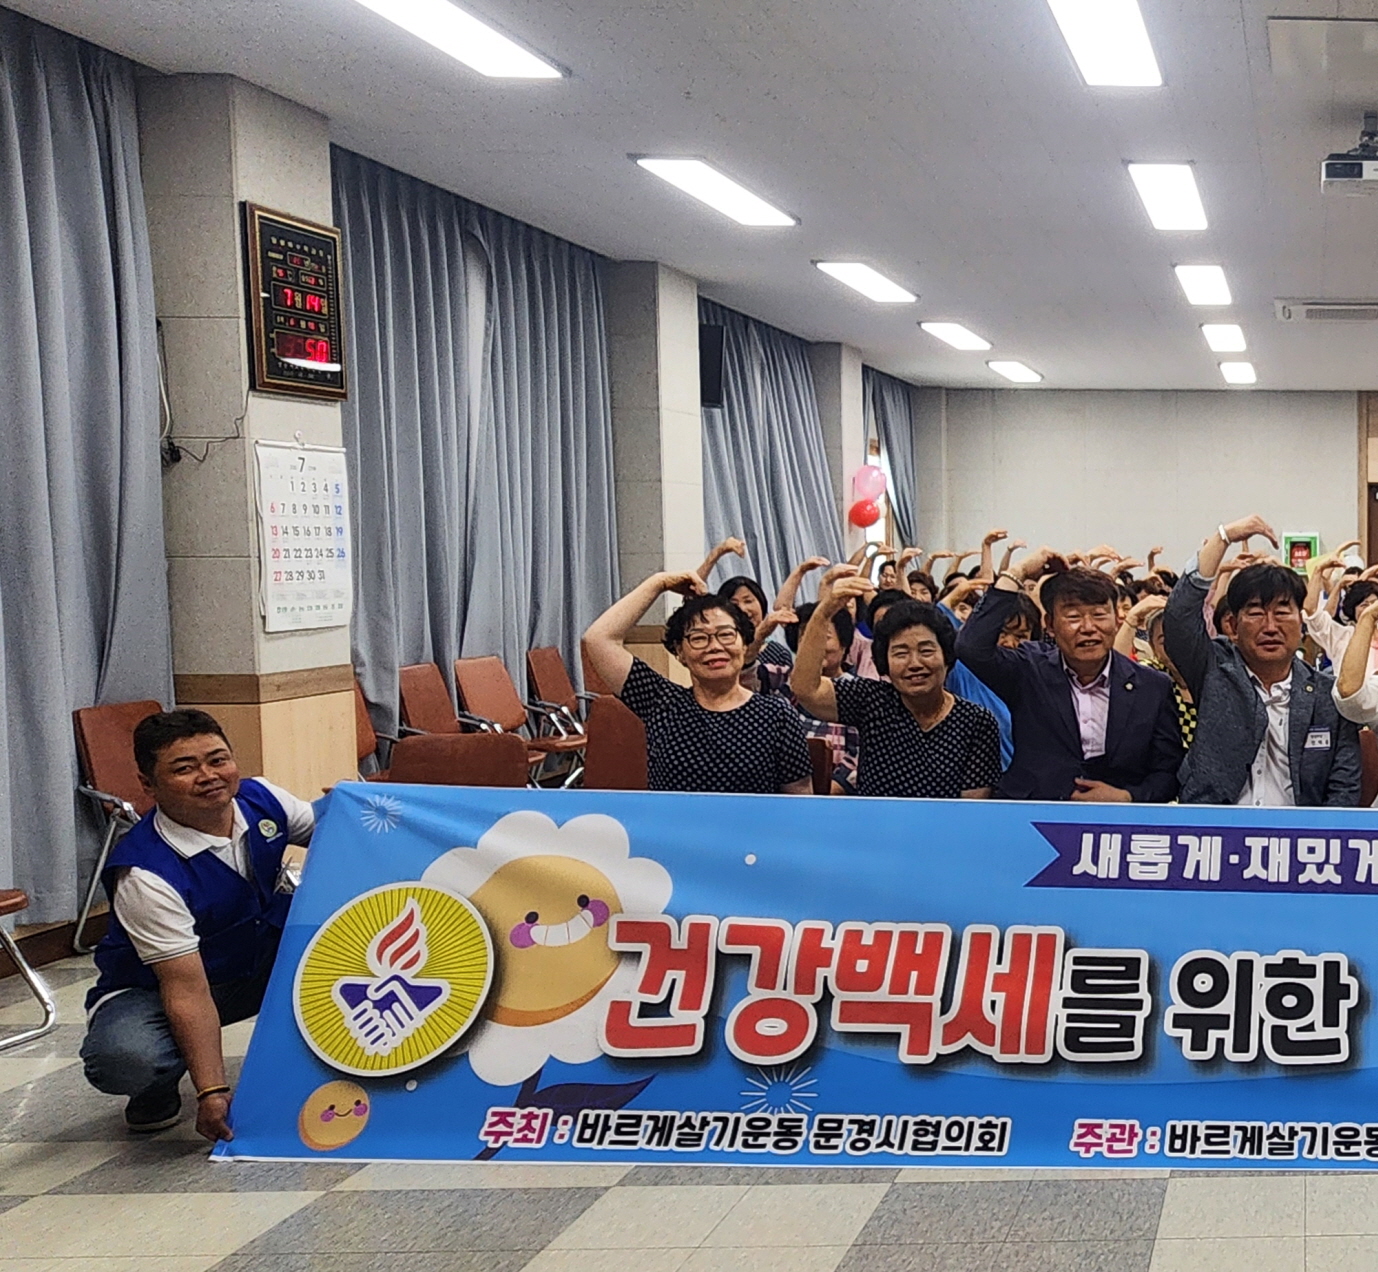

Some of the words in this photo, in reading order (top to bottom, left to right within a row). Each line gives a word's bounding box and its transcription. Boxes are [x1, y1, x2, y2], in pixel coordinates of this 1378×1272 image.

[283, 288, 293, 307] 7
[306, 293, 320, 312] 14
[305, 338, 328, 363] 50
[298, 456, 306, 473] 7
[290, 480, 295, 491] 1
[300, 481, 306, 492] 2
[312, 482, 317, 493] 3
[323, 483, 329, 494] 4
[334, 484, 340, 494] 5
[270, 502, 276, 513] 6
[281, 503, 286, 514] 7
[292, 503, 297, 514] 8
[302, 504, 308, 514] 9
[312, 504, 320, 515] 10
[323, 504, 330, 515] 11
[334, 505, 342, 516] 12
[270, 526, 278, 536] 13
[281, 526, 289, 536] 14
[292, 526, 300, 536] 15
[302, 526, 311, 536] 16
[314, 526, 320, 536] 17
[324, 526, 332, 536] 18
[335, 526, 343, 537] 19
[272, 548, 280, 558] 20
[283, 548, 290, 558] 21
[293, 548, 302, 558] 22
[304, 548, 313, 558] 23
[314, 548, 323, 558] 24
[325, 548, 334, 558] 25
[336, 548, 346, 558] 26
[273, 571, 282, 581] 27
[284, 571, 294, 581] 28
[295, 570, 304, 580] 29
[306, 570, 316, 580] 30
[317, 570, 325, 580] 31
[602, 917, 1147, 1060] 건강백세를
[1171, 954, 1352, 1061] 위한
[481, 1110, 549, 1146] 주최
[576, 1111, 800, 1151] 바르게살기운동
[812, 1116, 1008, 1154] 문경시협의회
[1071, 1120, 1139, 1156] 주관
